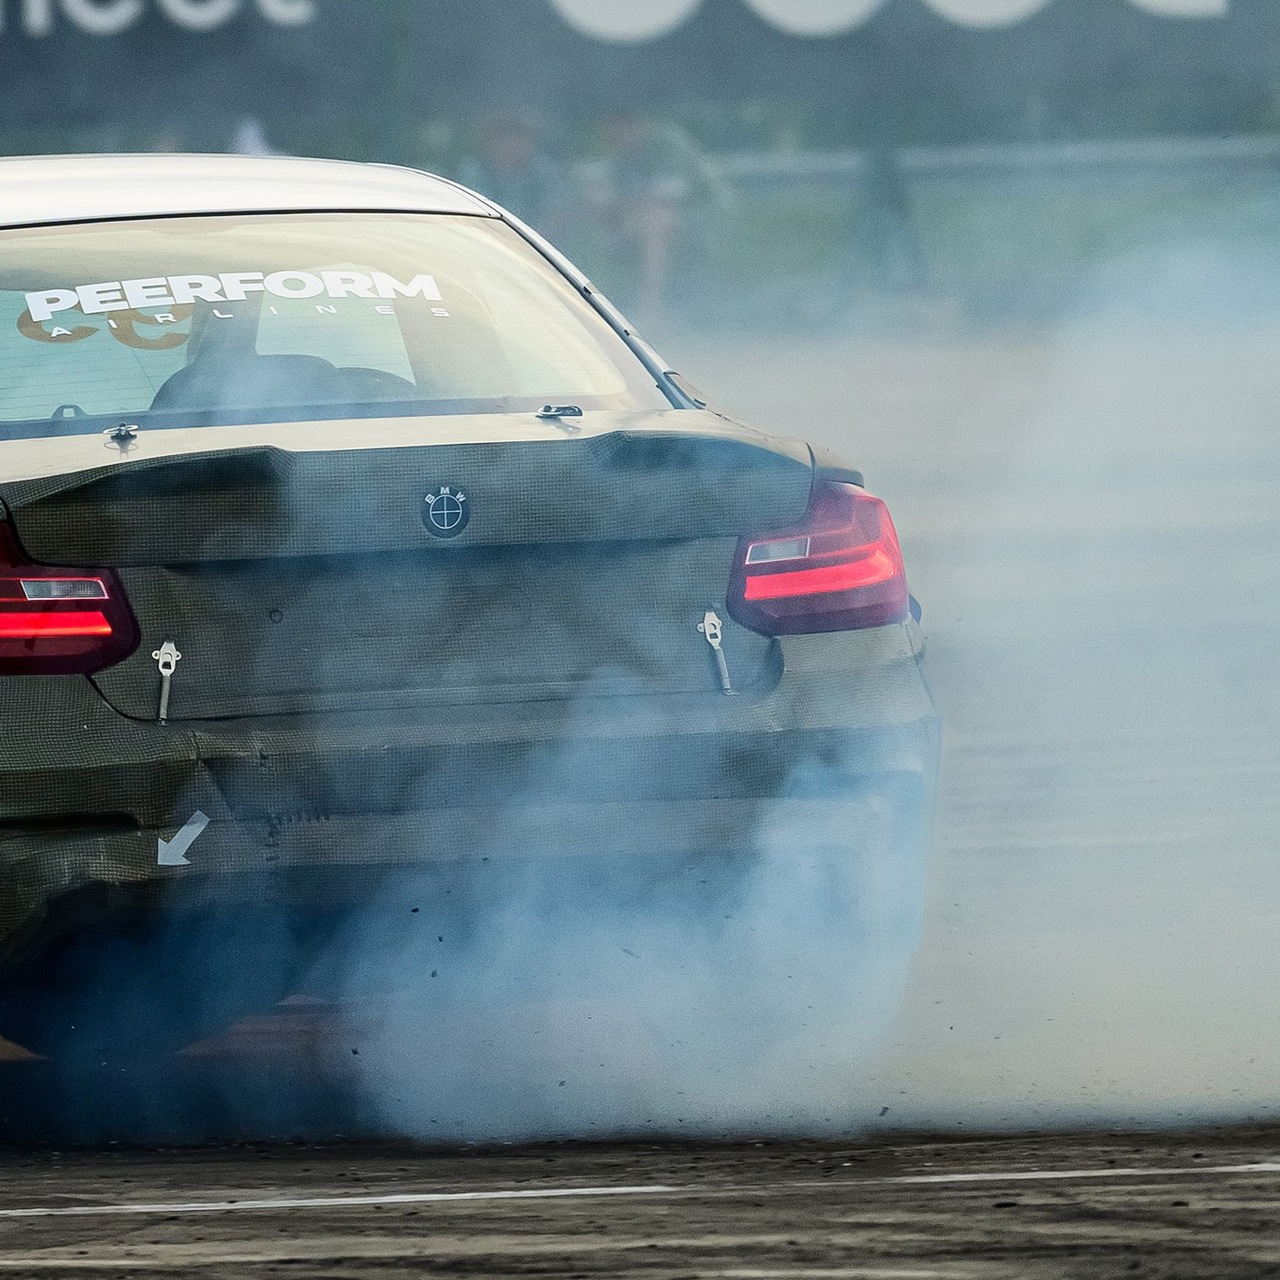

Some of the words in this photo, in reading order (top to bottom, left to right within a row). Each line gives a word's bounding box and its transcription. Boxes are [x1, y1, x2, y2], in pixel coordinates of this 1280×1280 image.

[24, 269, 444, 322] PEERFORM
[51, 304, 451, 338] AIRLINES
[424, 486, 466, 504] BMW
